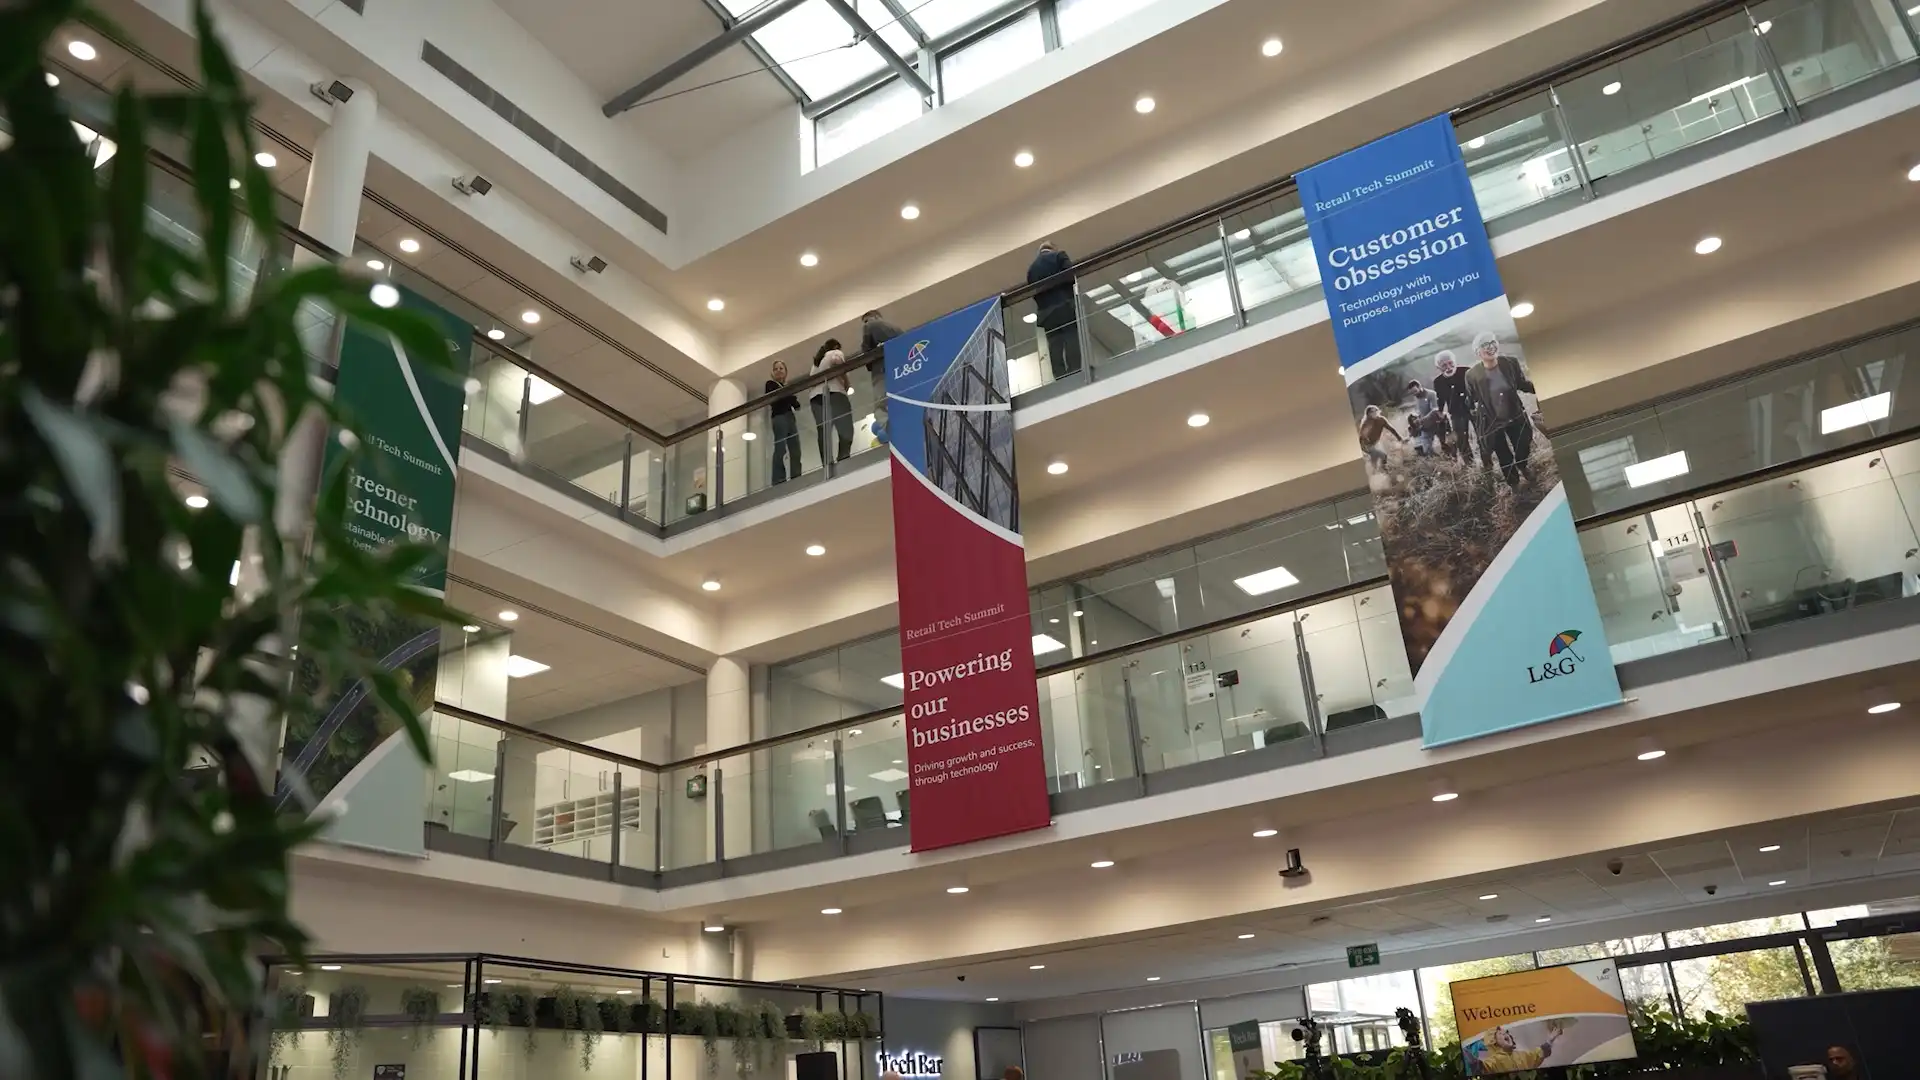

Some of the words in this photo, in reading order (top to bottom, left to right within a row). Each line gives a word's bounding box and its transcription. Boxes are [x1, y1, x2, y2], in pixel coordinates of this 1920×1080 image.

[1315, 192, 1351, 213] Retail
[1352, 179, 1383, 198] Tech
[1385, 158, 1436, 185] Summit
[1552, 173, 1571, 186] 213
[1328, 206, 1463, 268] Customer
[1334, 231, 1468, 291] obsession
[1338, 284, 1403, 313] Technology
[1406, 274, 1432, 291] with
[1343, 305, 1392, 328] purpose,
[1394, 285, 1439, 309] inspired
[1440, 279, 1456, 293] by
[1458, 271, 1480, 288] you
[893, 359, 922, 380] L&G
[376, 437, 401, 458] Tech
[403, 450, 443, 476] Summit
[1666, 533, 1689, 547] 114
[906, 624, 936, 640] Retail
[938, 616, 962, 631] Tech
[963, 603, 1005, 623] Summit
[909, 648, 1013, 692] Powering
[1188, 661, 1206, 673] 113
[1527, 657, 1576, 684] L&G
[911, 696, 949, 719] our
[912, 704, 1030, 748] businesses
[914, 759, 945, 774] Driving
[946, 751, 978, 768] growth
[980, 746, 997, 758] and
[998, 738, 1036, 754] success,
[915, 771, 949, 787] through
[950, 760, 999, 779] technology
[1461, 1002, 1536, 1023] Welcome
[879, 1052, 916, 1074] Tech
[918, 1053, 944, 1074] Bar
